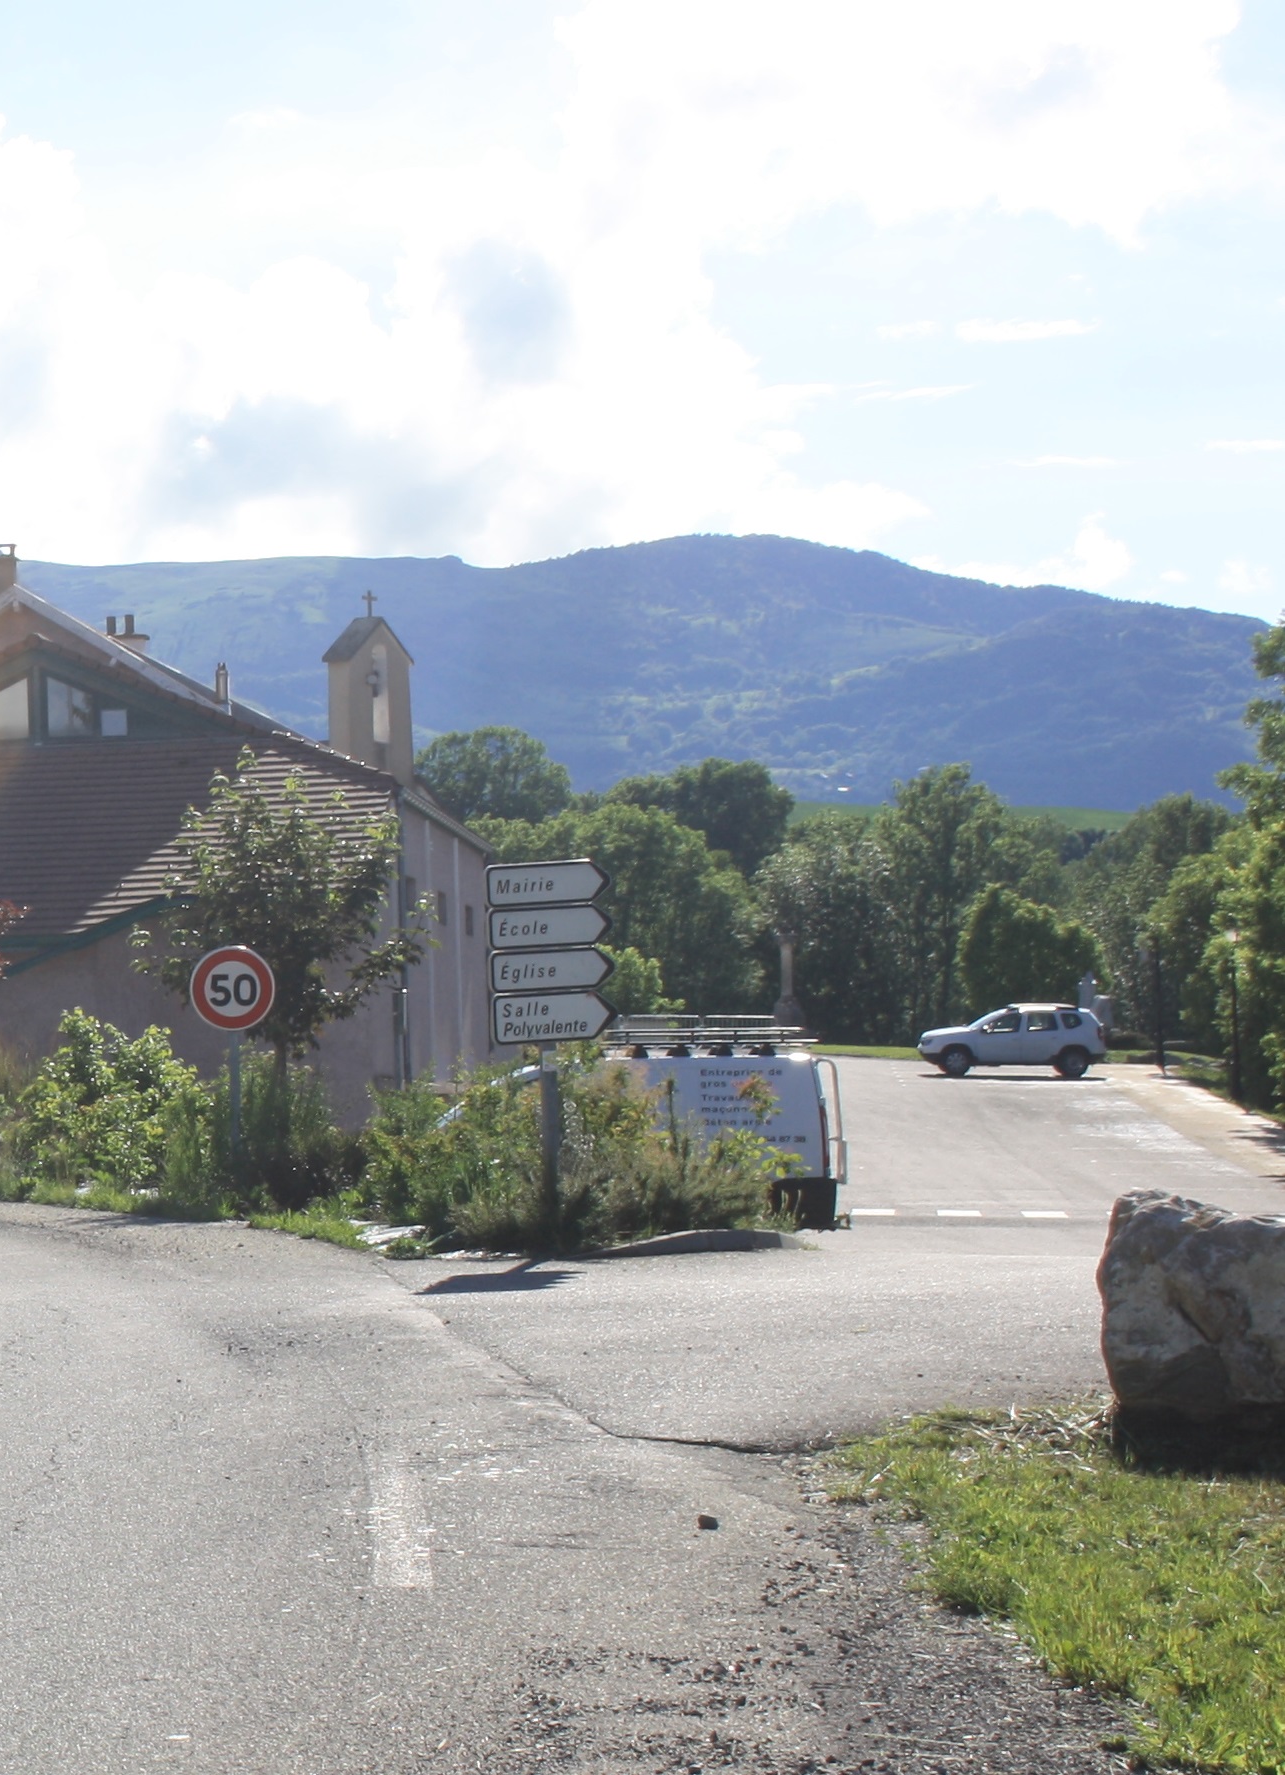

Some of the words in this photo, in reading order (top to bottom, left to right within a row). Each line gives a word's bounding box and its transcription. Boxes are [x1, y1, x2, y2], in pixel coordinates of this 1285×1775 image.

[496, 876, 554, 894] Mairie
[499, 918, 549, 937] École
[500, 961, 557, 983] Église
[210, 973, 258, 1007] 50
[502, 1002, 549, 1018] Salle
[503, 1020, 589, 1038] Polyvalente
[768, 1069, 783, 1077] de
[700, 1081, 727, 1089] gros
